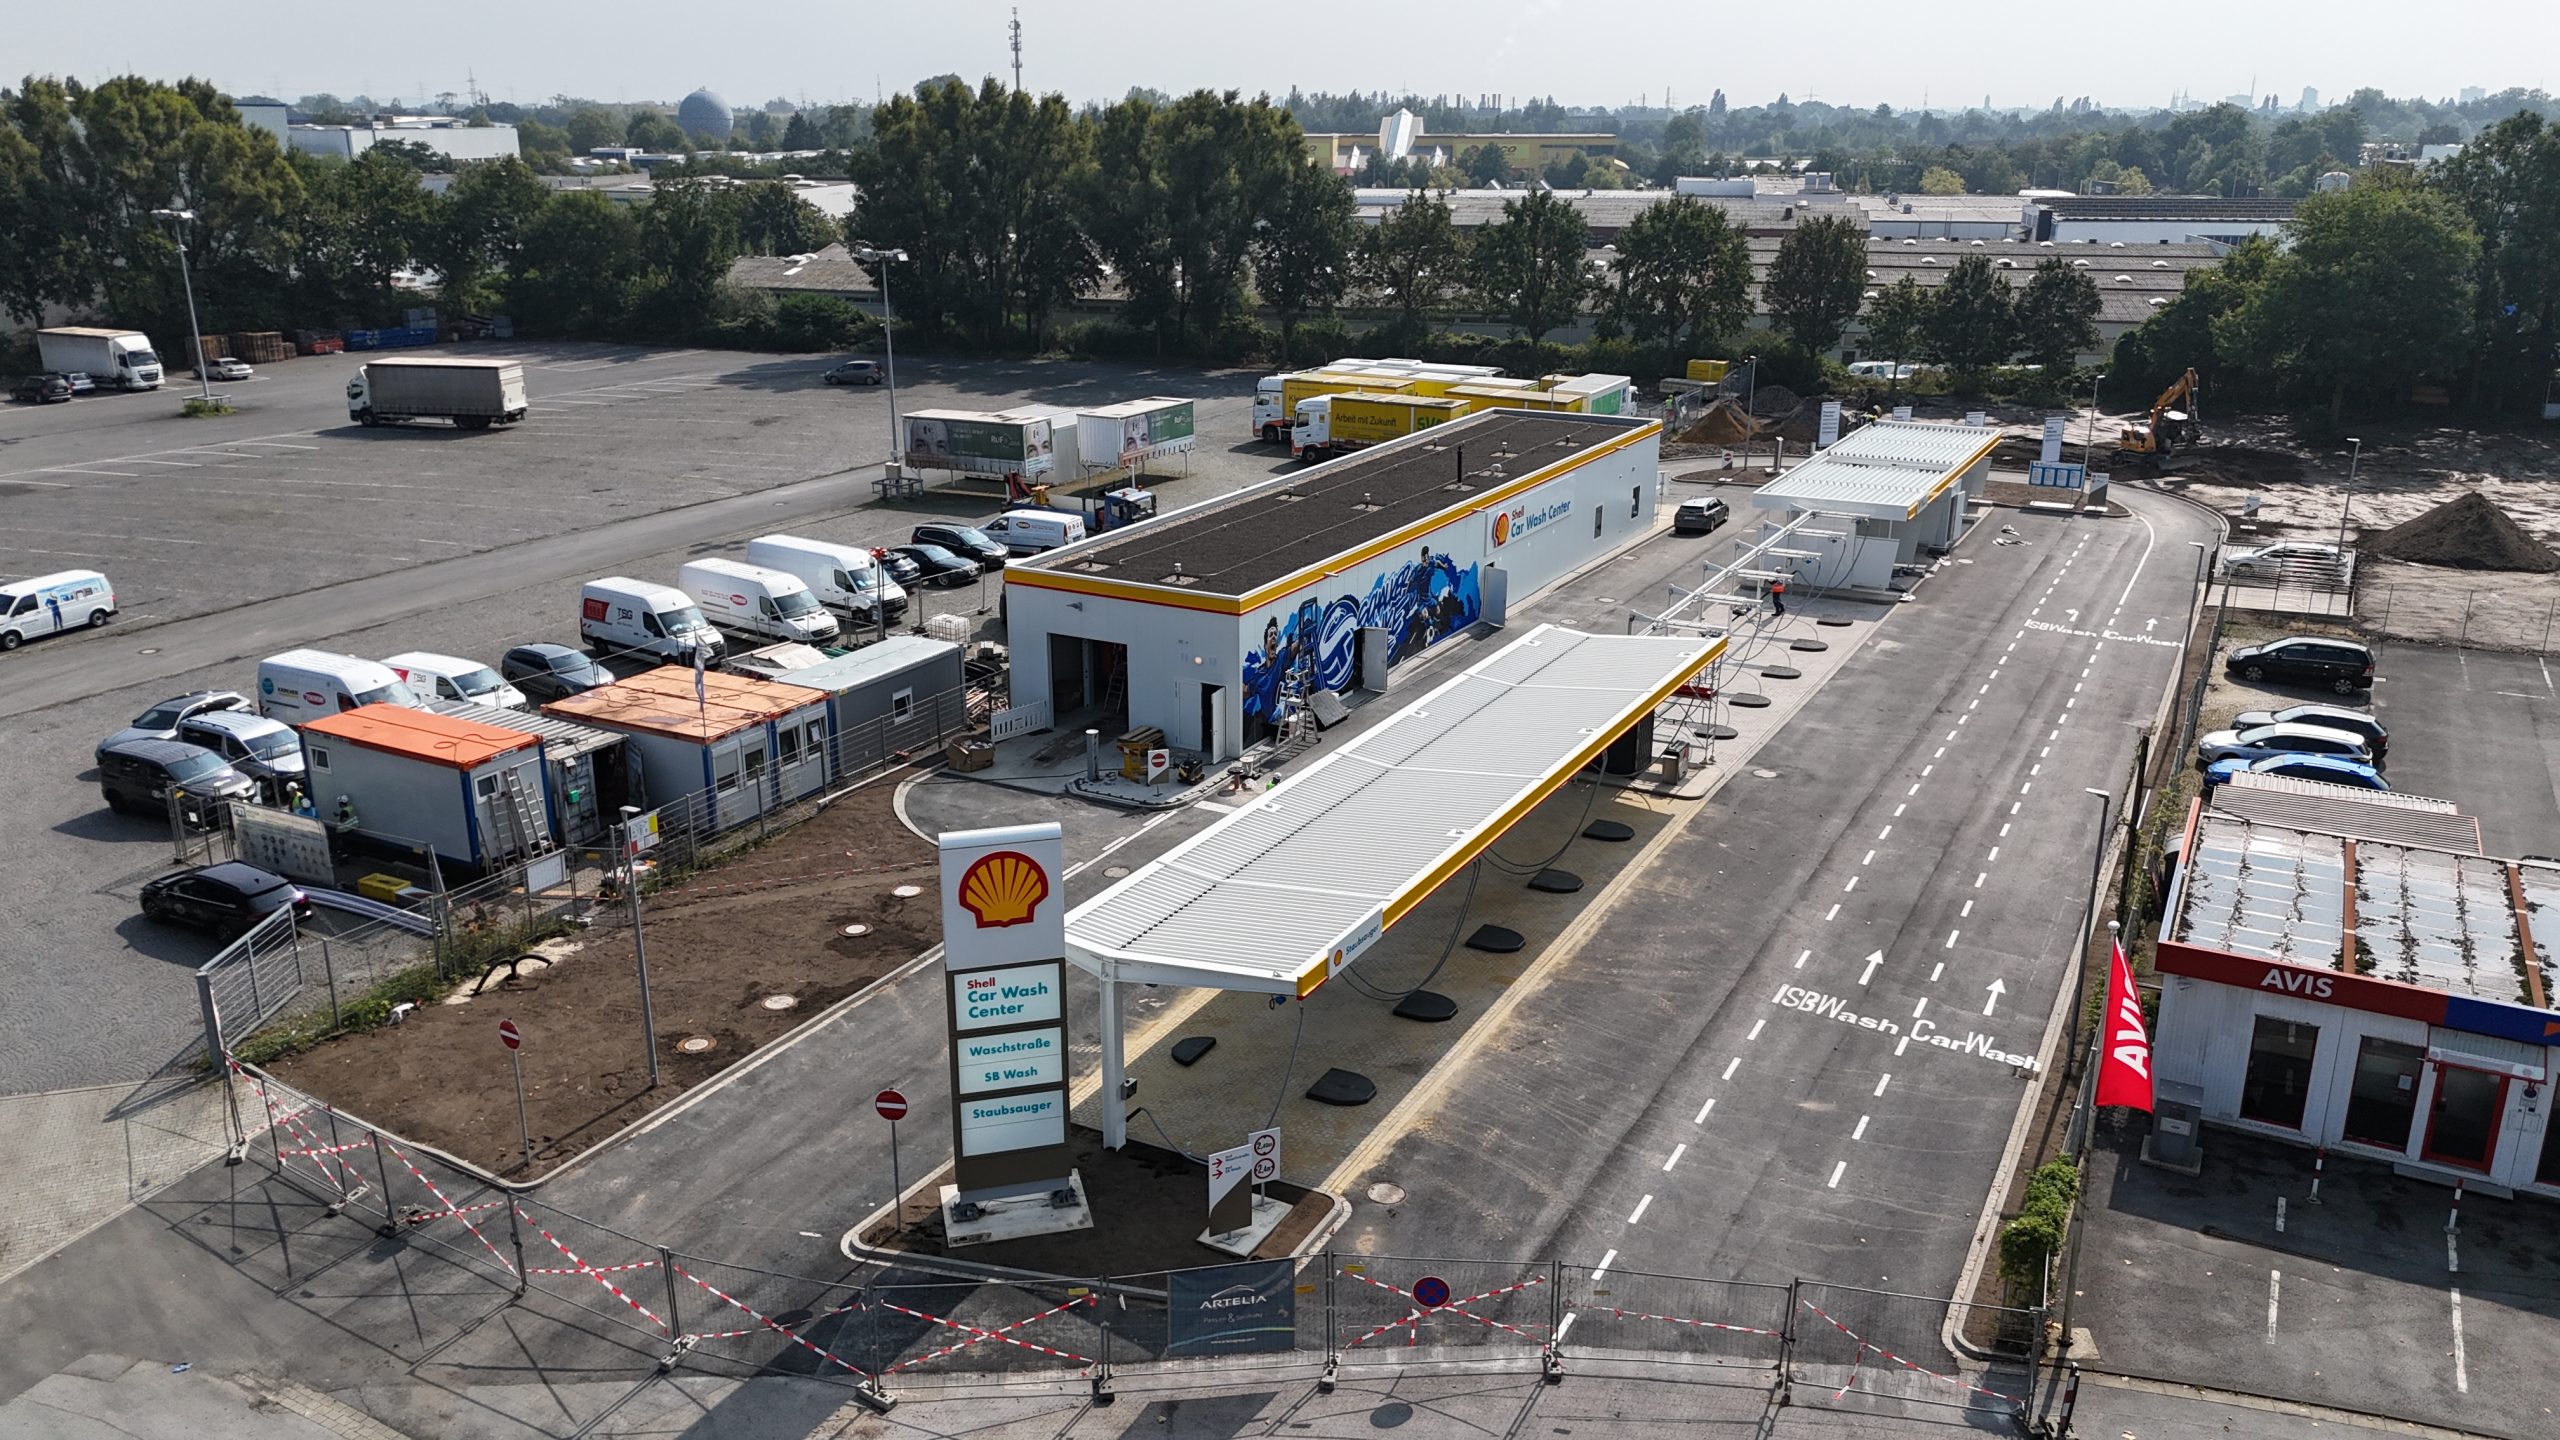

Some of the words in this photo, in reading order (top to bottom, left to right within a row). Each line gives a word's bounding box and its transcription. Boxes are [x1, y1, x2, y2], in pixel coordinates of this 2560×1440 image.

[1335, 414, 1356, 425] Arbeit
[1357, 415, 1369, 425] mit
[1369, 415, 1397, 427] Zukunft
[1511, 505, 1525, 521] Shell
[1511, 521, 1525, 538] Car
[1526, 507, 1547, 531] Wash
[1548, 500, 1571, 520] Center
[1345, 924, 1379, 956] Staubsauger
[966, 976, 996, 990] Shell
[2260, 968, 2335, 998] AVIS
[967, 990, 998, 1003] Car
[1000, 981, 1049, 999] Wash
[967, 1003, 1025, 1019] Center
[969, 1037, 1051, 1057] Waschstraße
[1909, 1018, 2042, 1072] CarWash
[984, 1070, 1001, 1082] SB
[1003, 1066, 1038, 1080] Wash
[972, 1101, 1053, 1119] Staubsauger
[1199, 1295, 1268, 1310] ARTELIA
[1227, 1312, 1236, 1324] &
